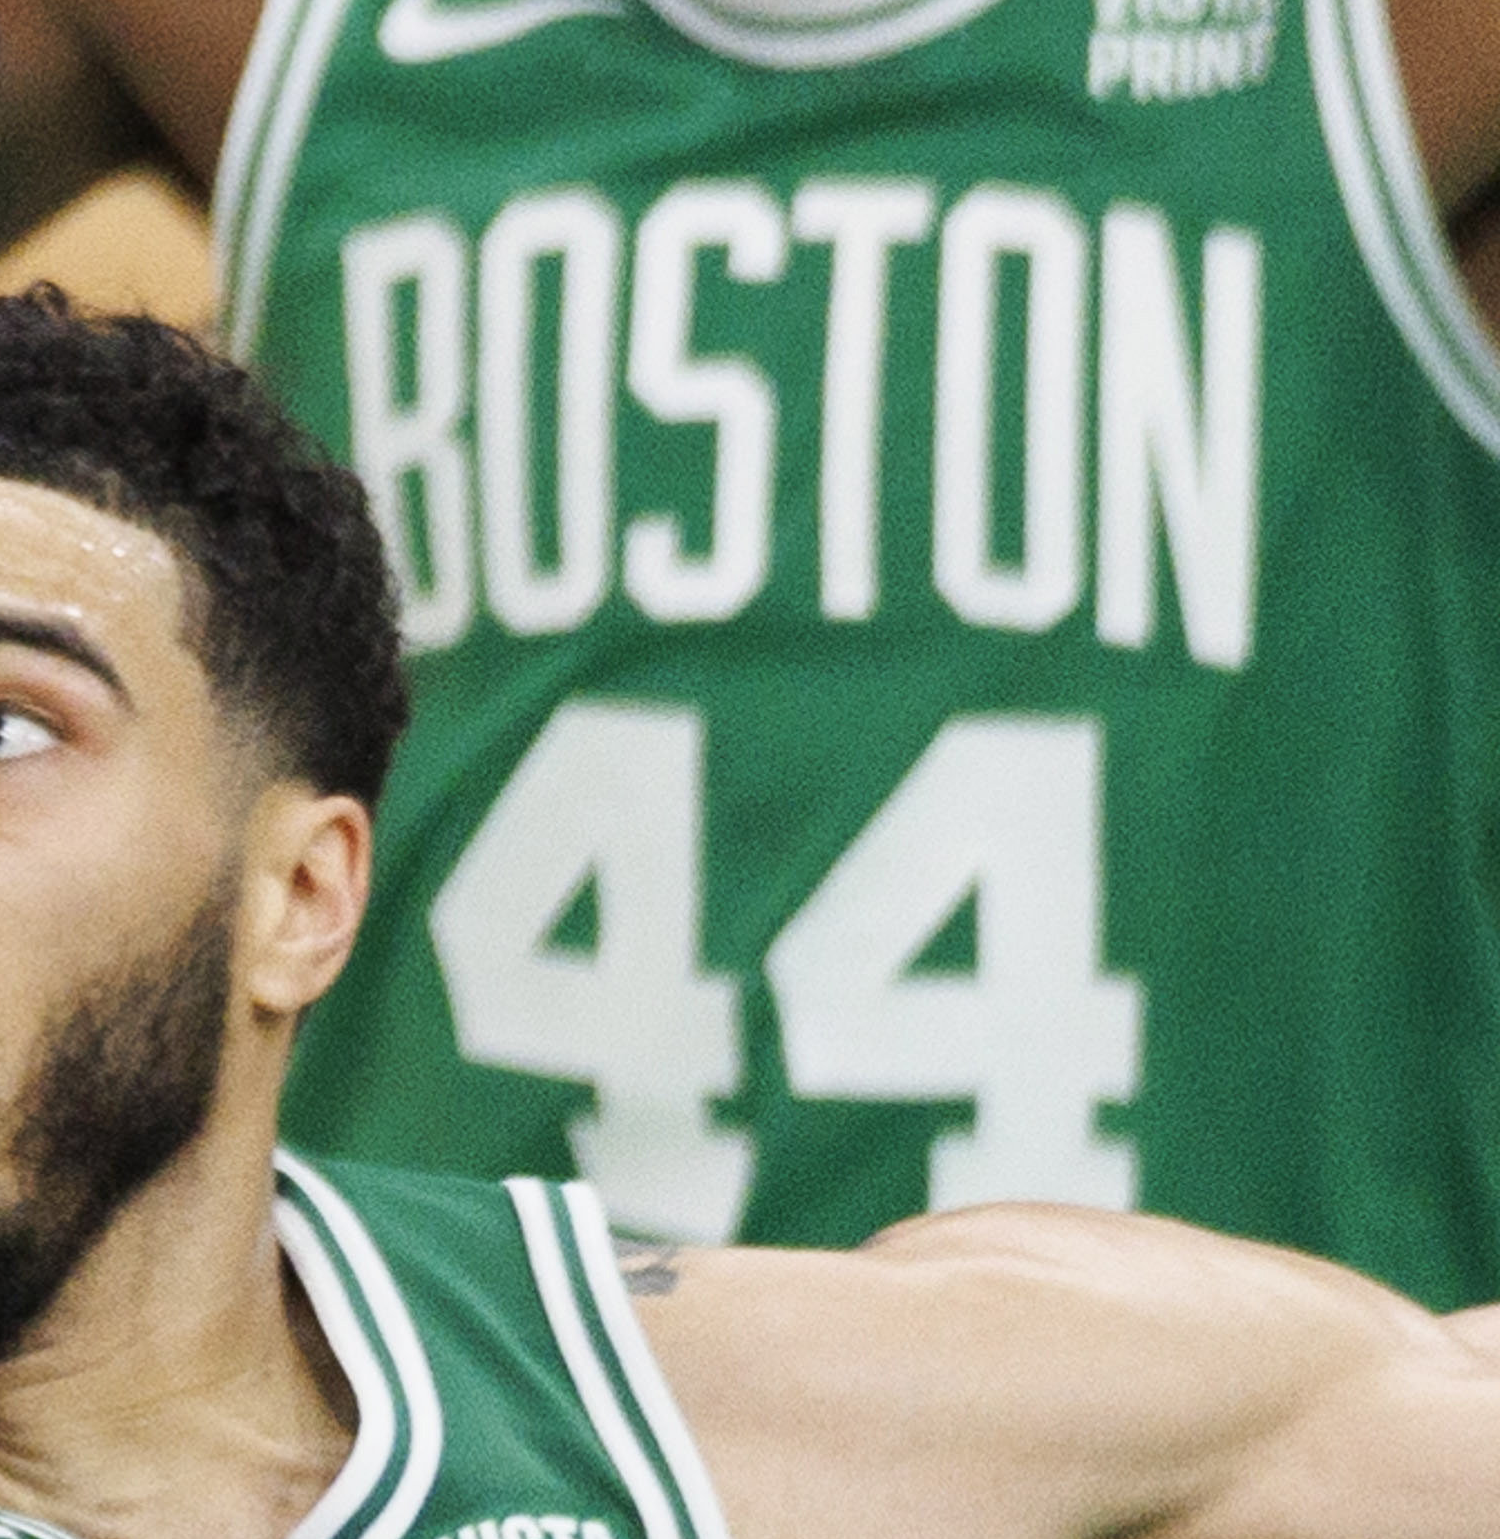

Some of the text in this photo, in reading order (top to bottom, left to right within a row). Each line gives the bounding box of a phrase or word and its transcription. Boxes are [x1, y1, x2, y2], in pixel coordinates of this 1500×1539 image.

[1085, 22, 1277, 101] PRINT
[340, 176, 1263, 671] BOSTON
[428, 703, 1145, 1249] 44
